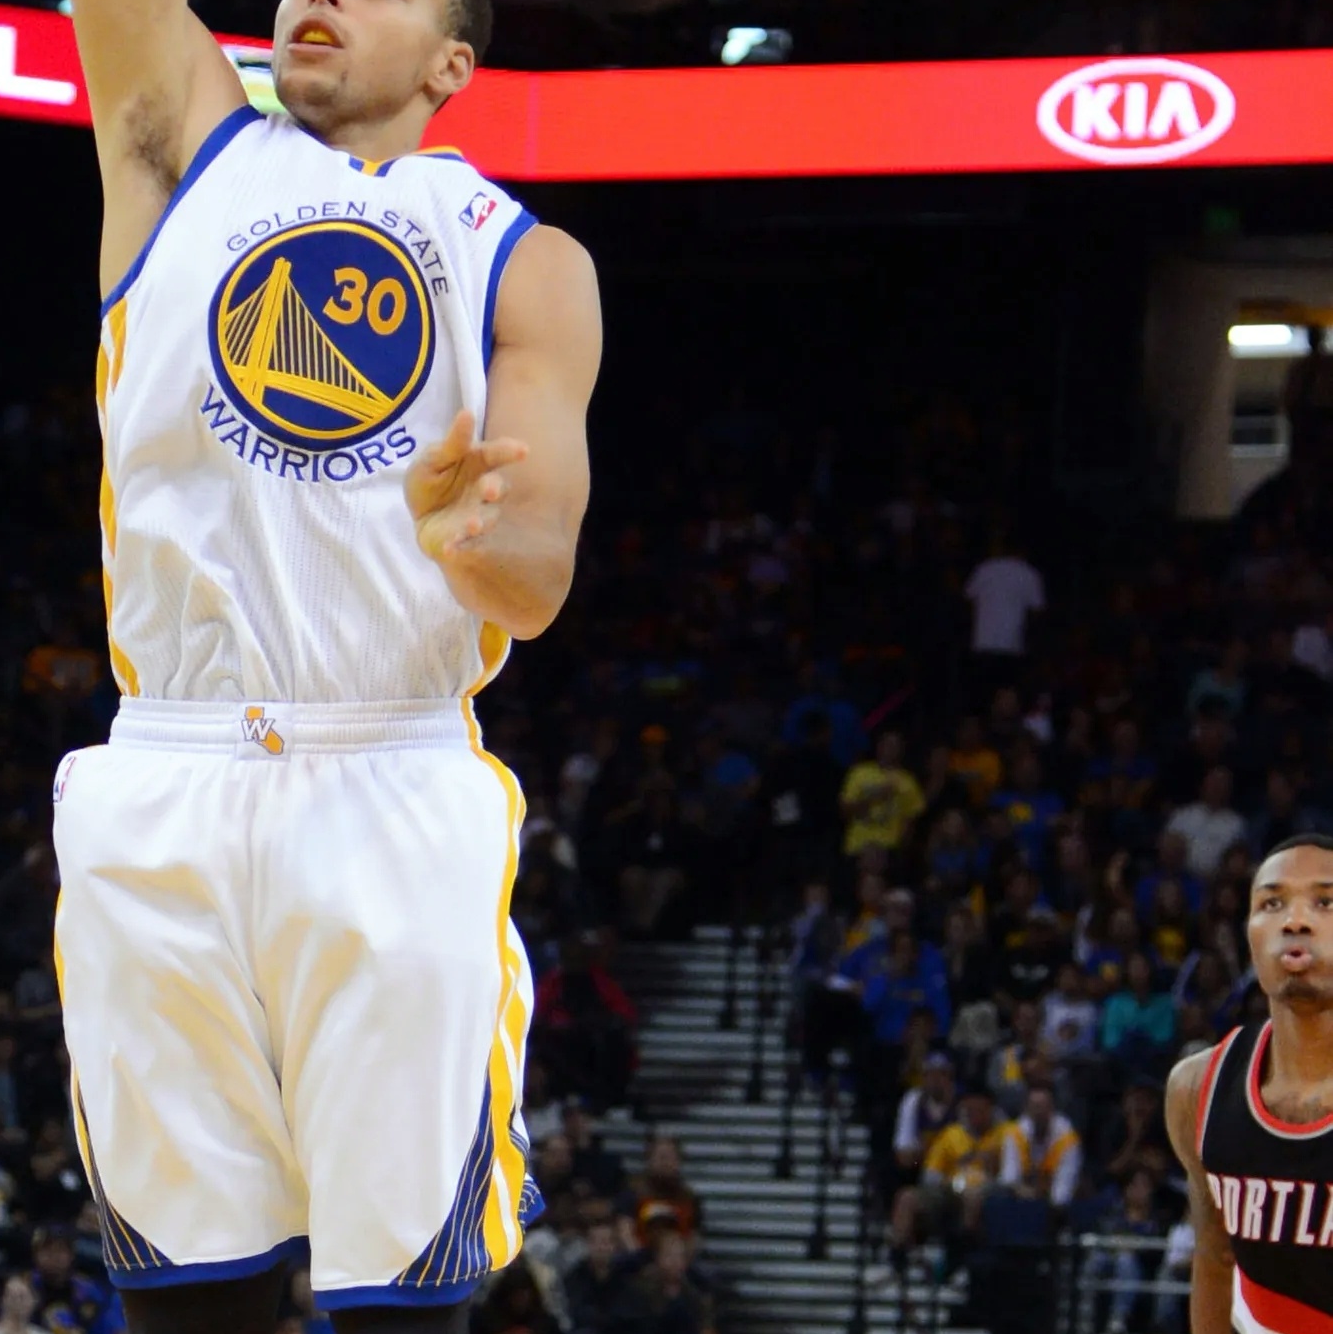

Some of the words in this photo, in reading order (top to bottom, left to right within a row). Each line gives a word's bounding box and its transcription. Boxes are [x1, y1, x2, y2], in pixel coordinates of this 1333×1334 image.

[1070, 81, 1201, 139] KIA
[226, 201, 367, 253] GOLDEN
[380, 210, 449, 298] STATE
[322, 267, 407, 335] 30
[200, 383, 416, 482] WARRIORS
